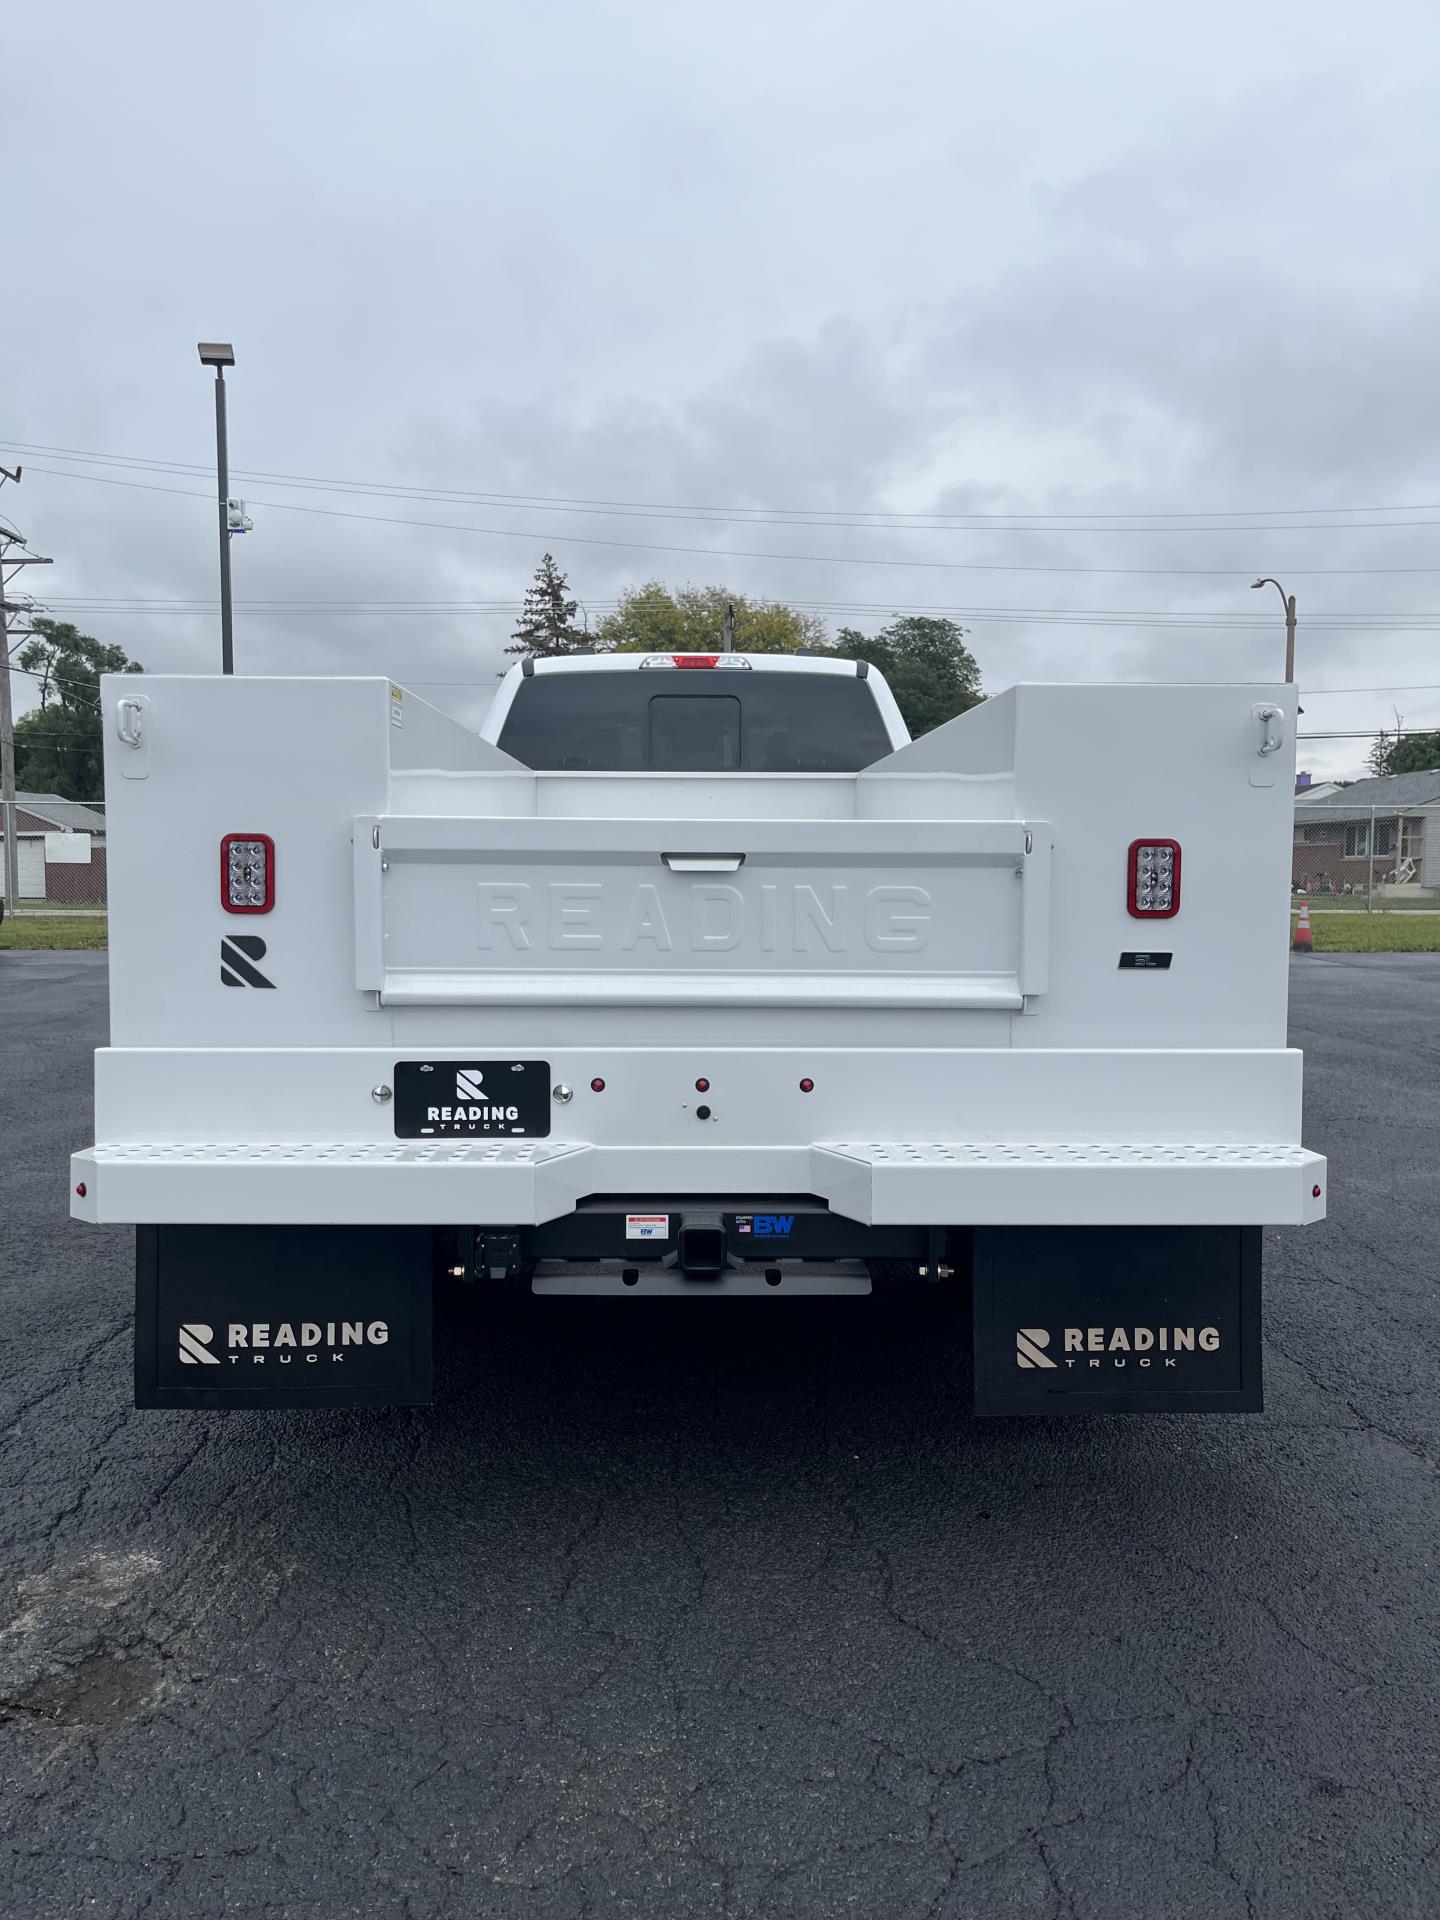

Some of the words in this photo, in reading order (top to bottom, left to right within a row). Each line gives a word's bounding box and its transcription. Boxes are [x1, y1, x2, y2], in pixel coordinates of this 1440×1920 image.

[476, 881, 933, 954] READING
[427, 1106, 519, 1121] READING
[228, 1320, 389, 1348] READING
[1064, 1327, 1220, 1352] READING
[228, 1353, 344, 1364] TRUCK
[1065, 1358, 1177, 1368] TRUCK
